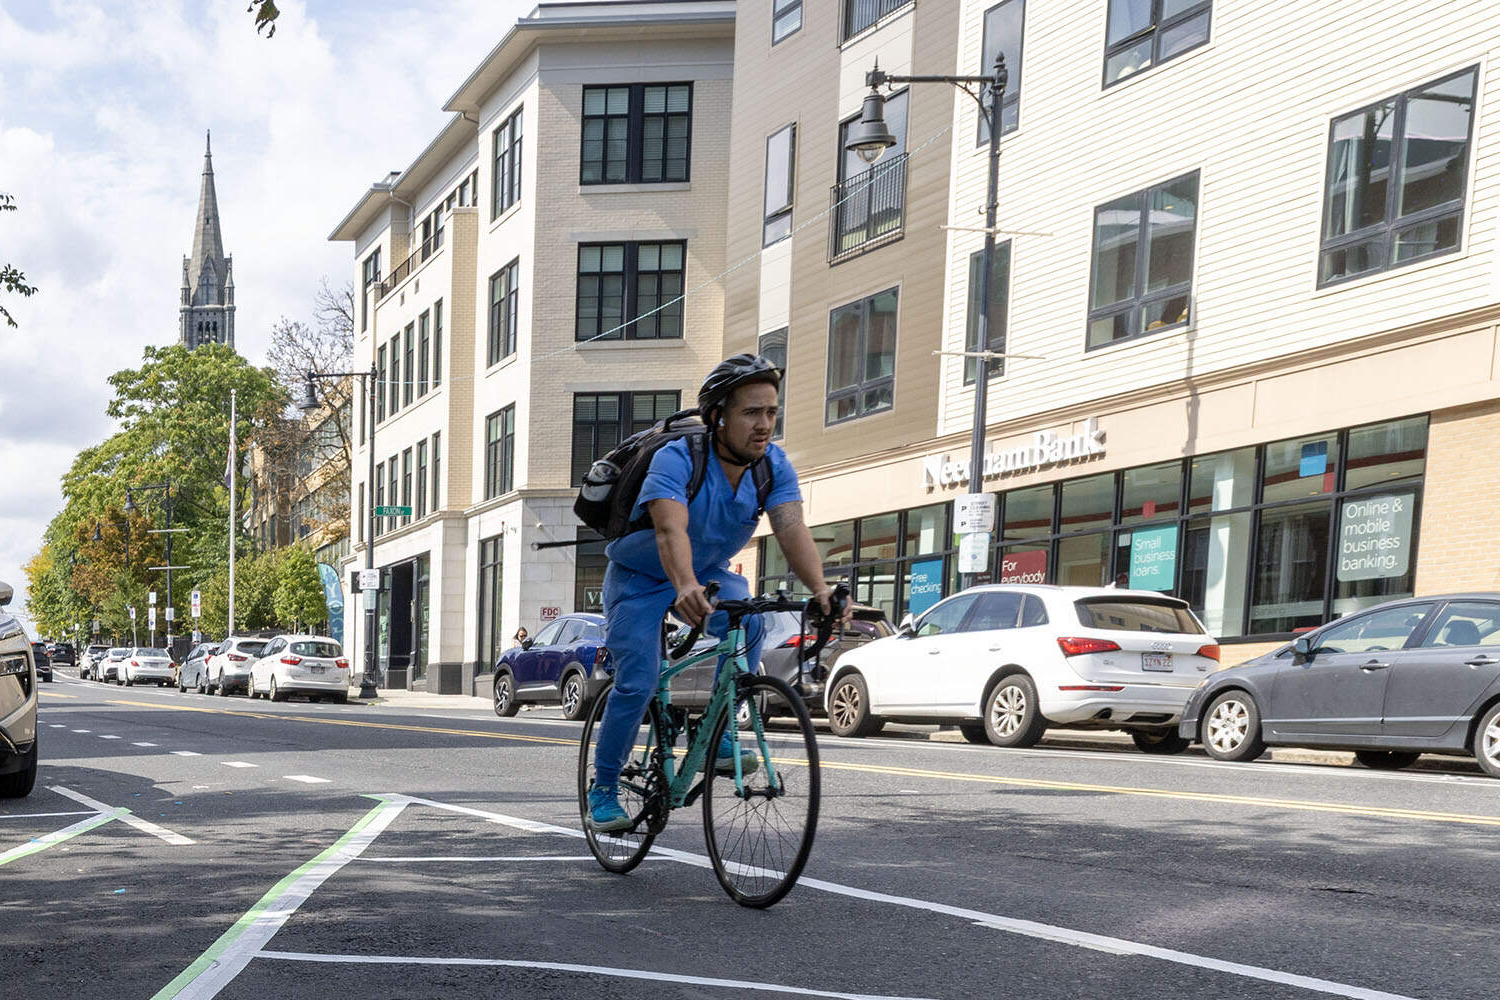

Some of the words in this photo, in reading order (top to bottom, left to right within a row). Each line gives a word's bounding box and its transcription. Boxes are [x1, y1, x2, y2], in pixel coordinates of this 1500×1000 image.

[921, 416, 1106, 490] NeehamBank
[1346, 502, 1389, 519] Online
[1392, 497, 1403, 513] &
[1344, 518, 1390, 536] mobile
[1134, 535, 1162, 551] Small
[1343, 536, 1400, 553] business
[1133, 550, 1176, 564] business
[1342, 554, 1398, 571] banking.
[1002, 560, 1018, 572] For
[911, 572, 927, 583] Free
[1001, 570, 1046, 584] everybody
[911, 582, 942, 595] checking
[542, 607, 559, 616] FDC
